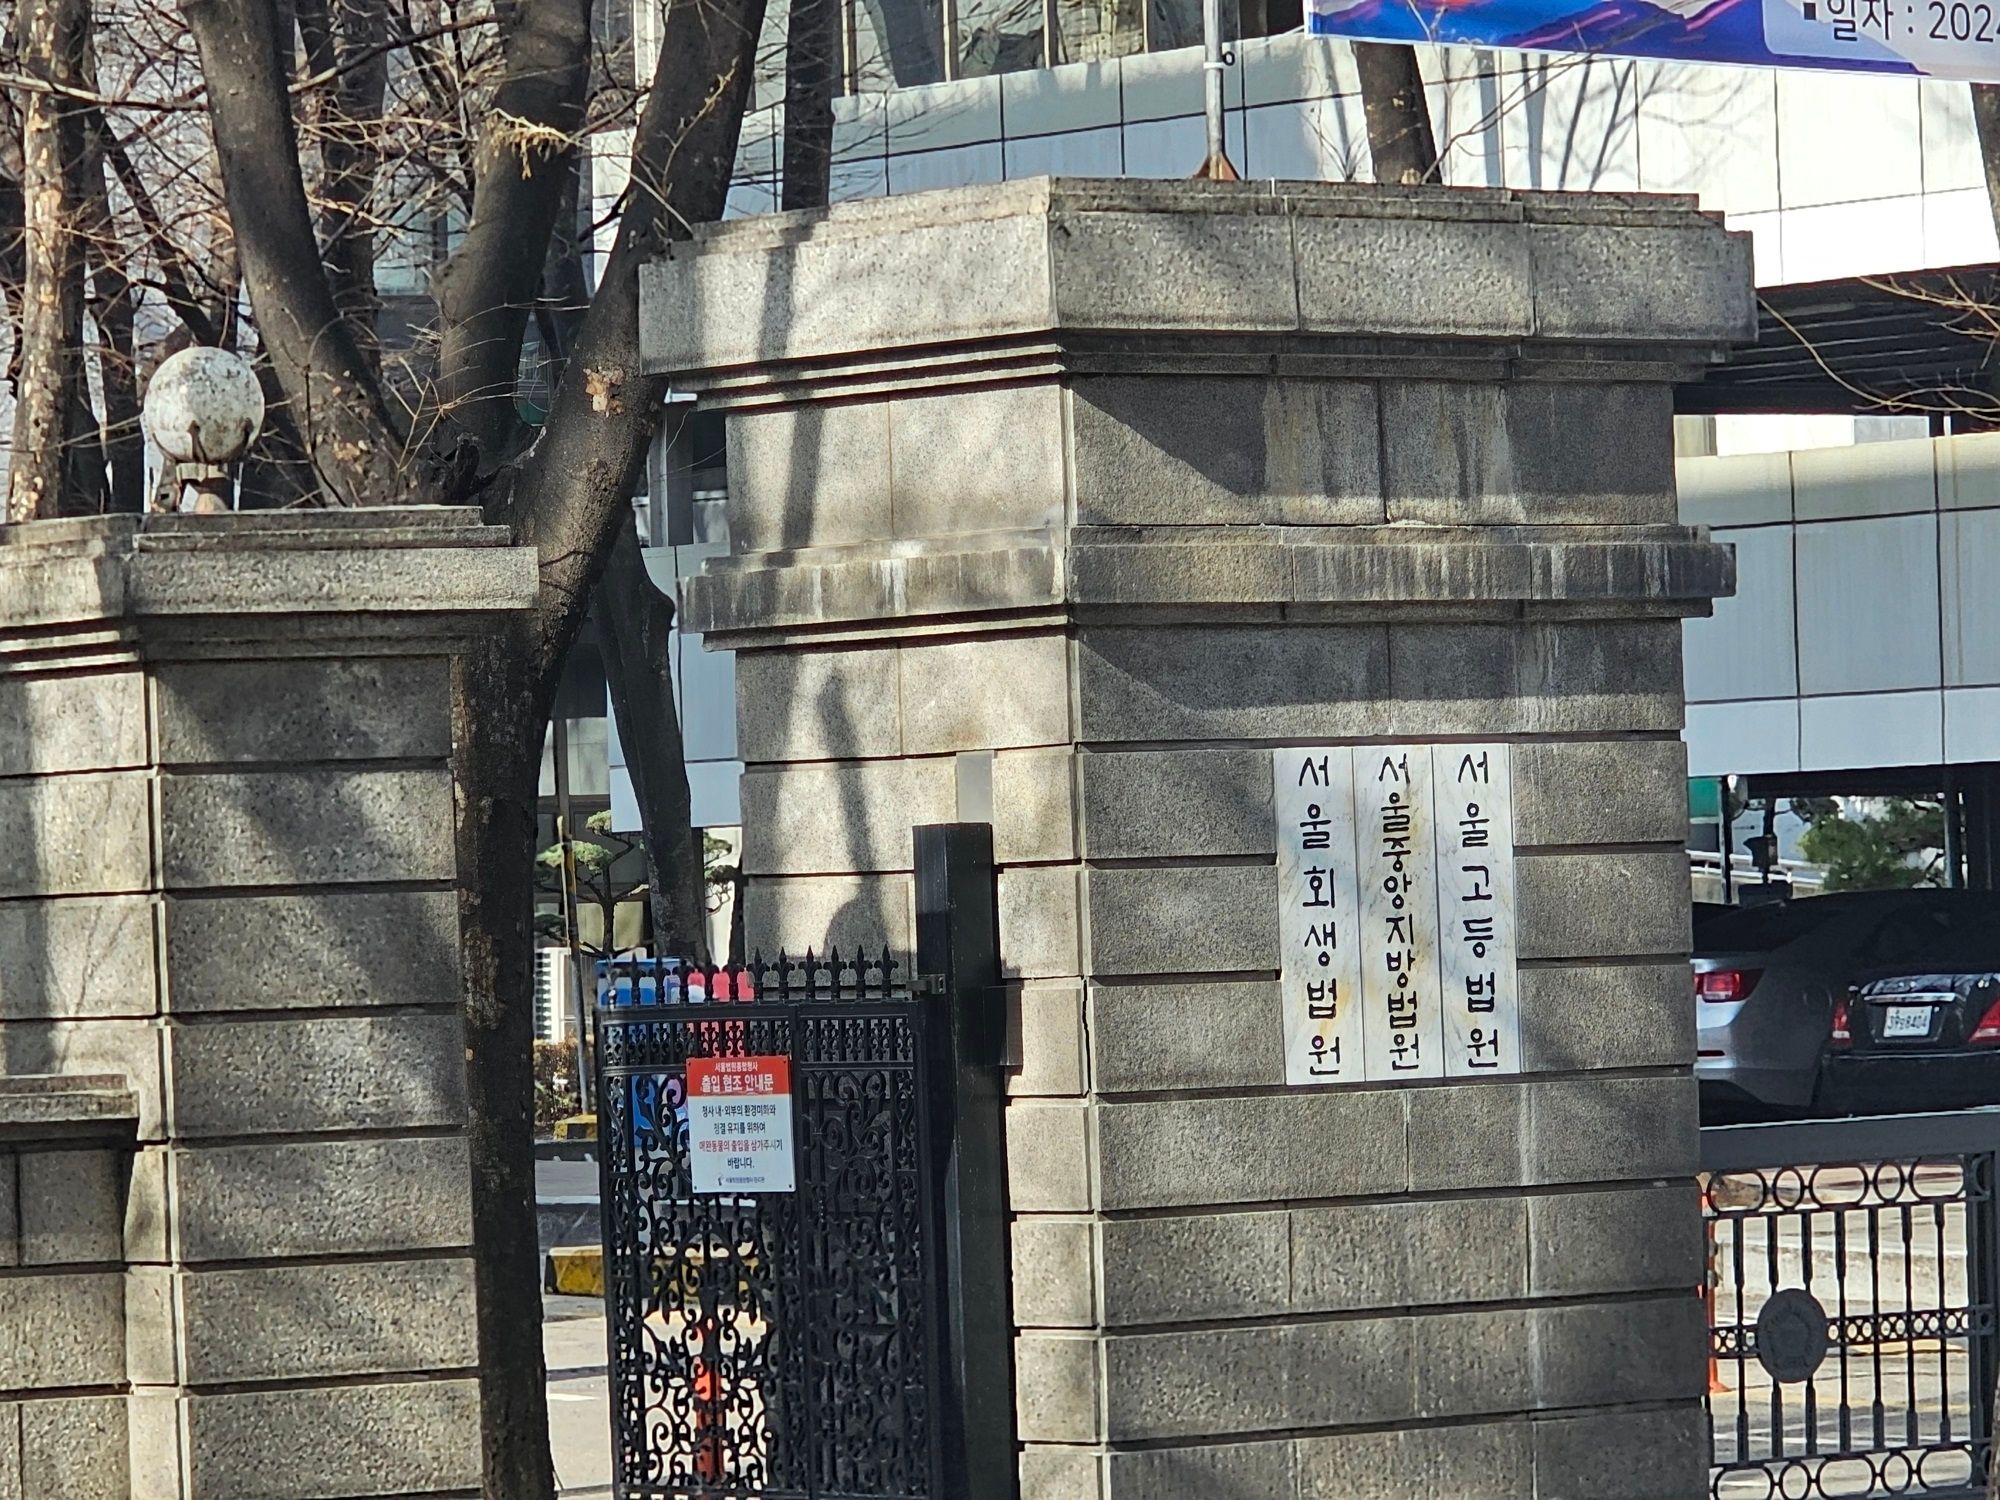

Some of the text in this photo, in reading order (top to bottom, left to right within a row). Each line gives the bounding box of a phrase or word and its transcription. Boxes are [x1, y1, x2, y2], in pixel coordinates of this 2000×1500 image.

[1827, 0, 1894, 41] 일자
[1928, 1, 2000, 42] 202
[1299, 755, 1340, 1075] 서울회생법원
[1378, 753, 1420, 1071] 서울중앙지방법원
[1458, 751, 1498, 1069] 서울고등법원
[701, 1074, 774, 1093] 출입 협조 안내문
[747, 1121, 766, 1134] 위하여
